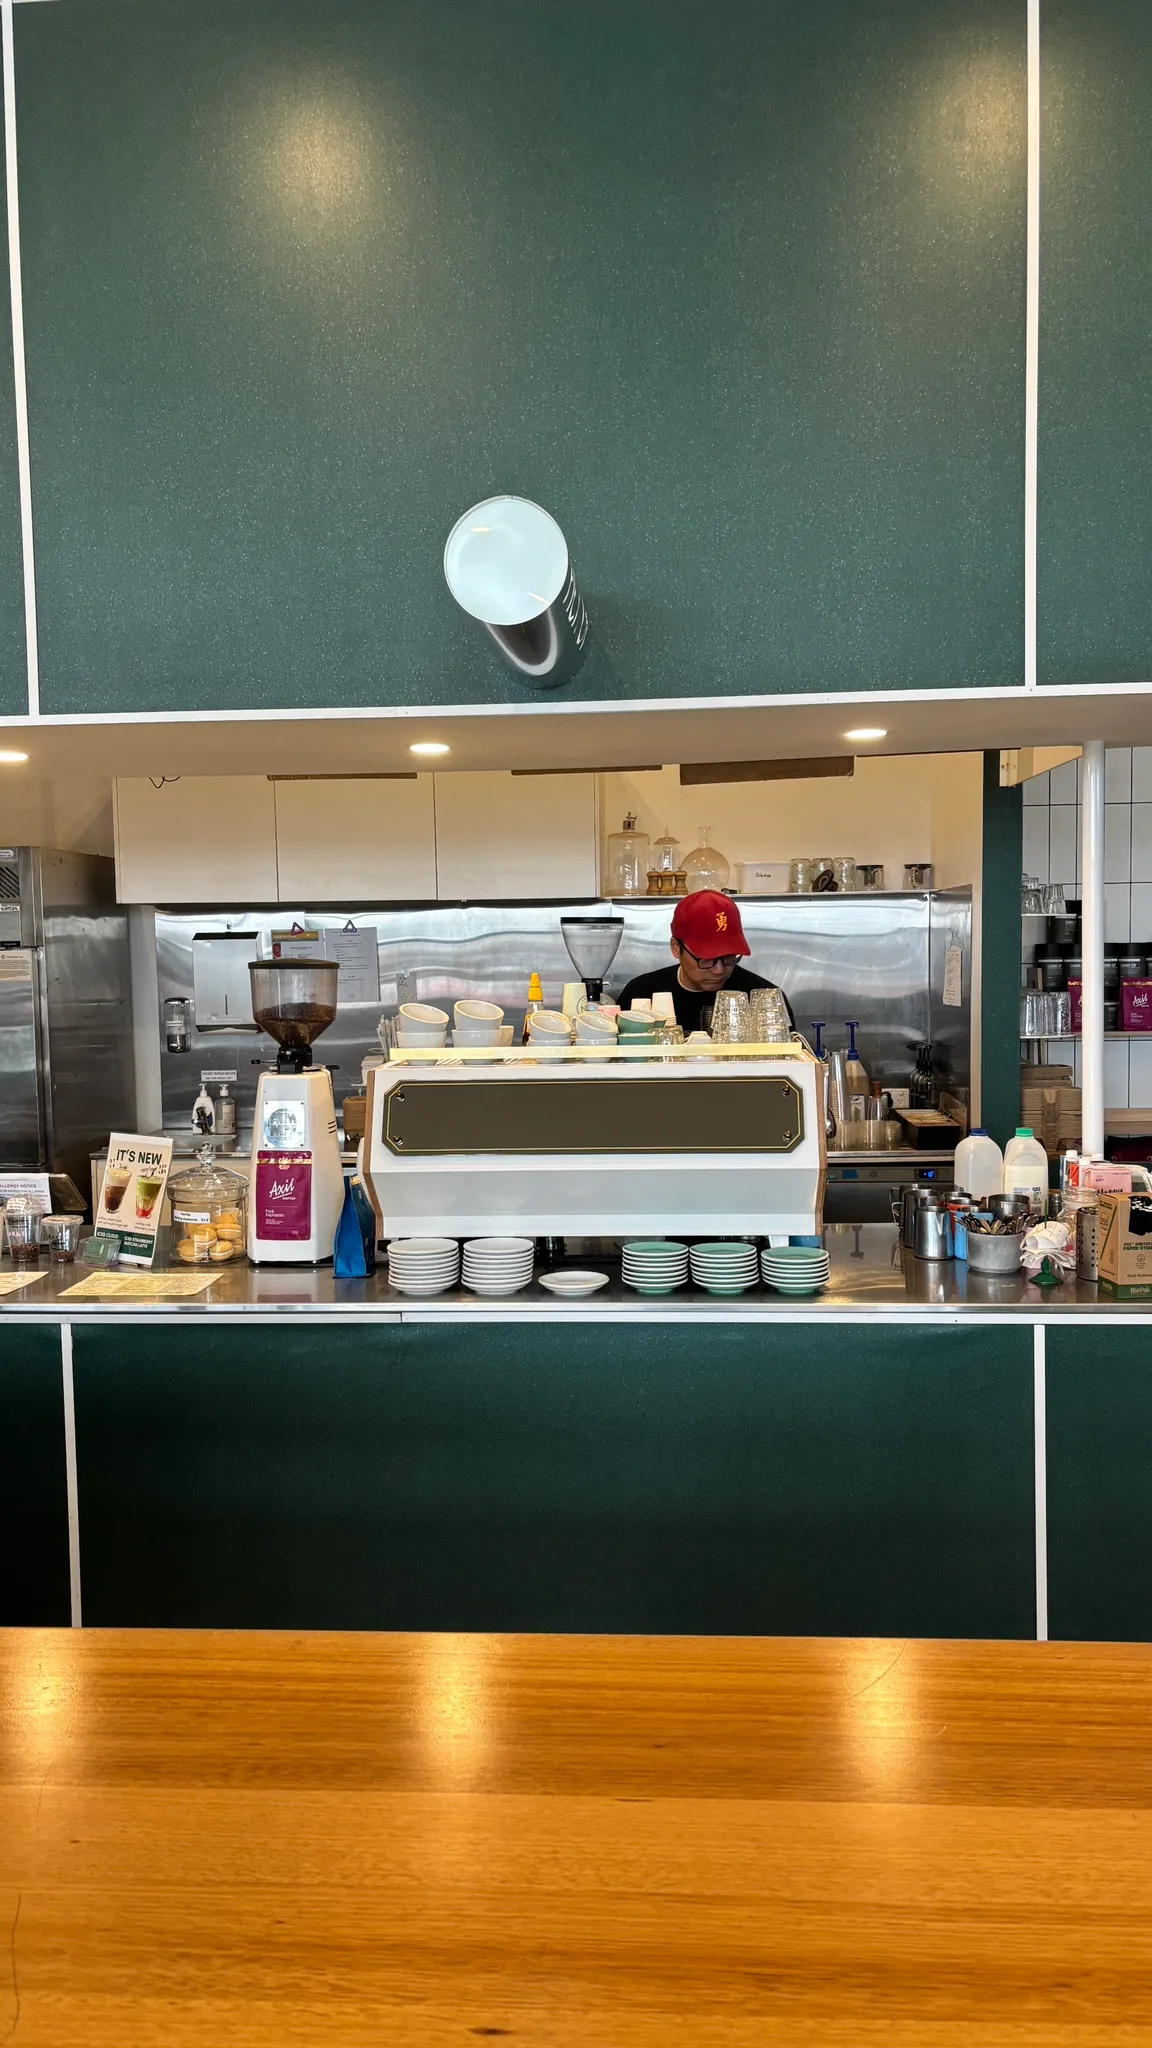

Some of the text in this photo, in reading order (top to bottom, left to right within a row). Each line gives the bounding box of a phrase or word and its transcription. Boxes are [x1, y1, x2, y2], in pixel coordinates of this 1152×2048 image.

[1132, 993, 1149, 1006] Axil
[116, 1148, 136, 1163] IT'S
[138, 1151, 163, 1165] NEW
[269, 1177, 295, 1198] Axil
